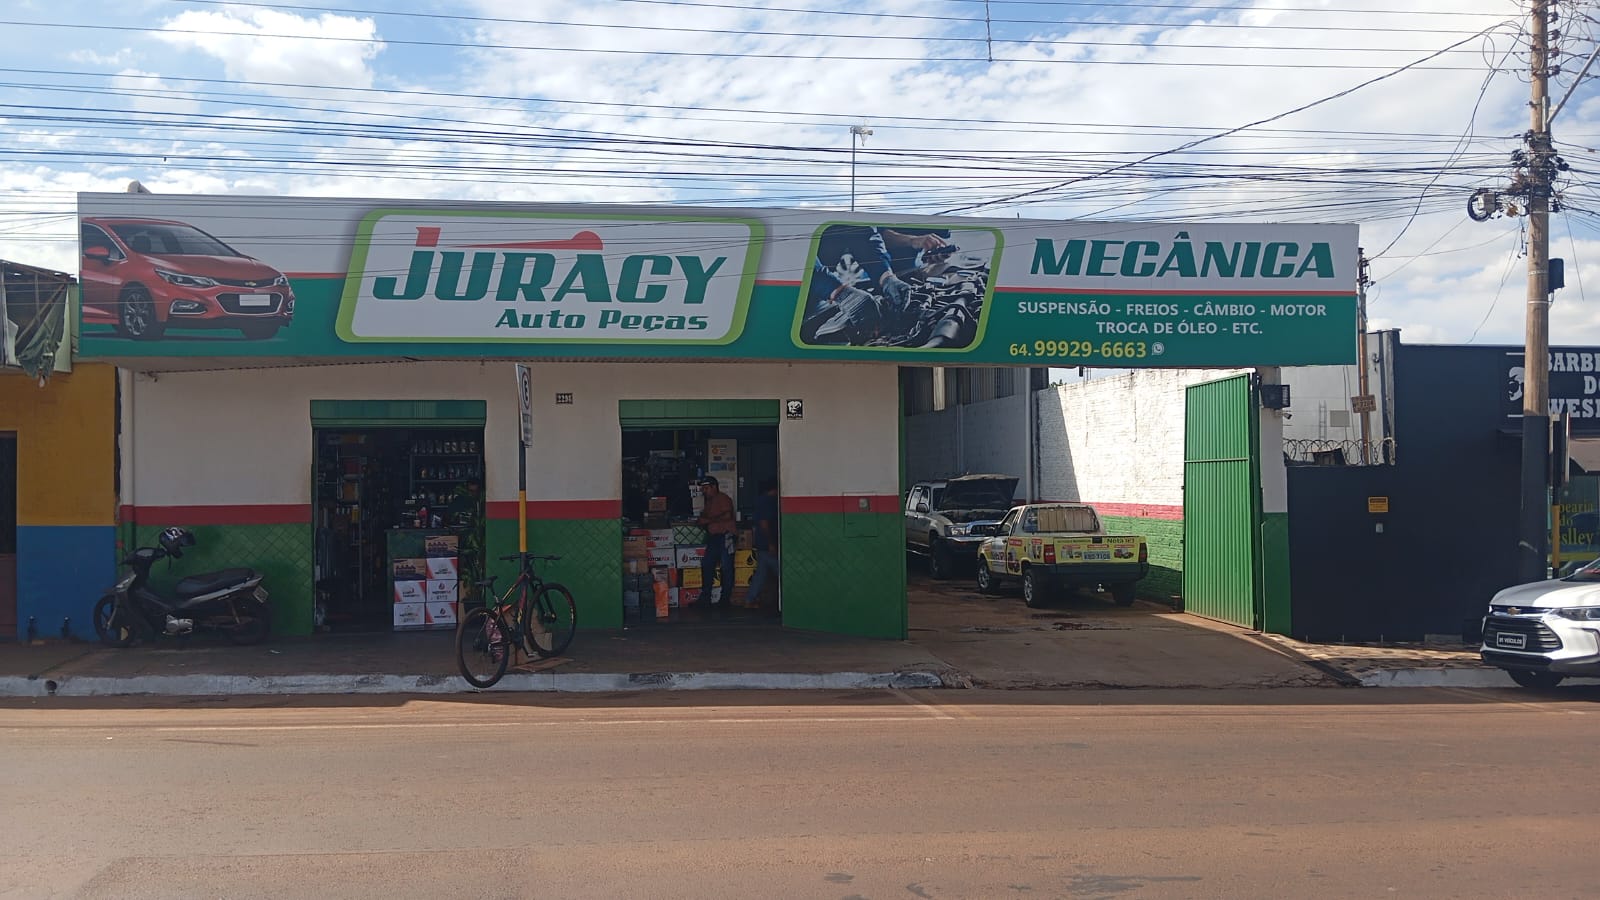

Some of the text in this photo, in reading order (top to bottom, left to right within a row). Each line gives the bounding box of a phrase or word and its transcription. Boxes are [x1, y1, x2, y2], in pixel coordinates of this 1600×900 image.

[1030, 231, 1335, 279] MECÂNICA
[372, 226, 728, 305] JURACY
[1018, 300, 1111, 315] SUSPENSÃO
[1126, 304, 1179, 316] FREIOS
[1193, 301, 1256, 316] CÂMBIO
[1270, 304, 1327, 316] MOTOR
[494, 308, 709, 332] Auto Peças
[1096, 321, 1149, 334] TROCA
[1153, 322, 1173, 334] DE
[1177, 319, 1218, 334] ÓLEO
[1232, 322, 1263, 335] ETC.
[1034, 340, 1147, 358] 99929-6663
[1583, 375, 1600, 395] D
